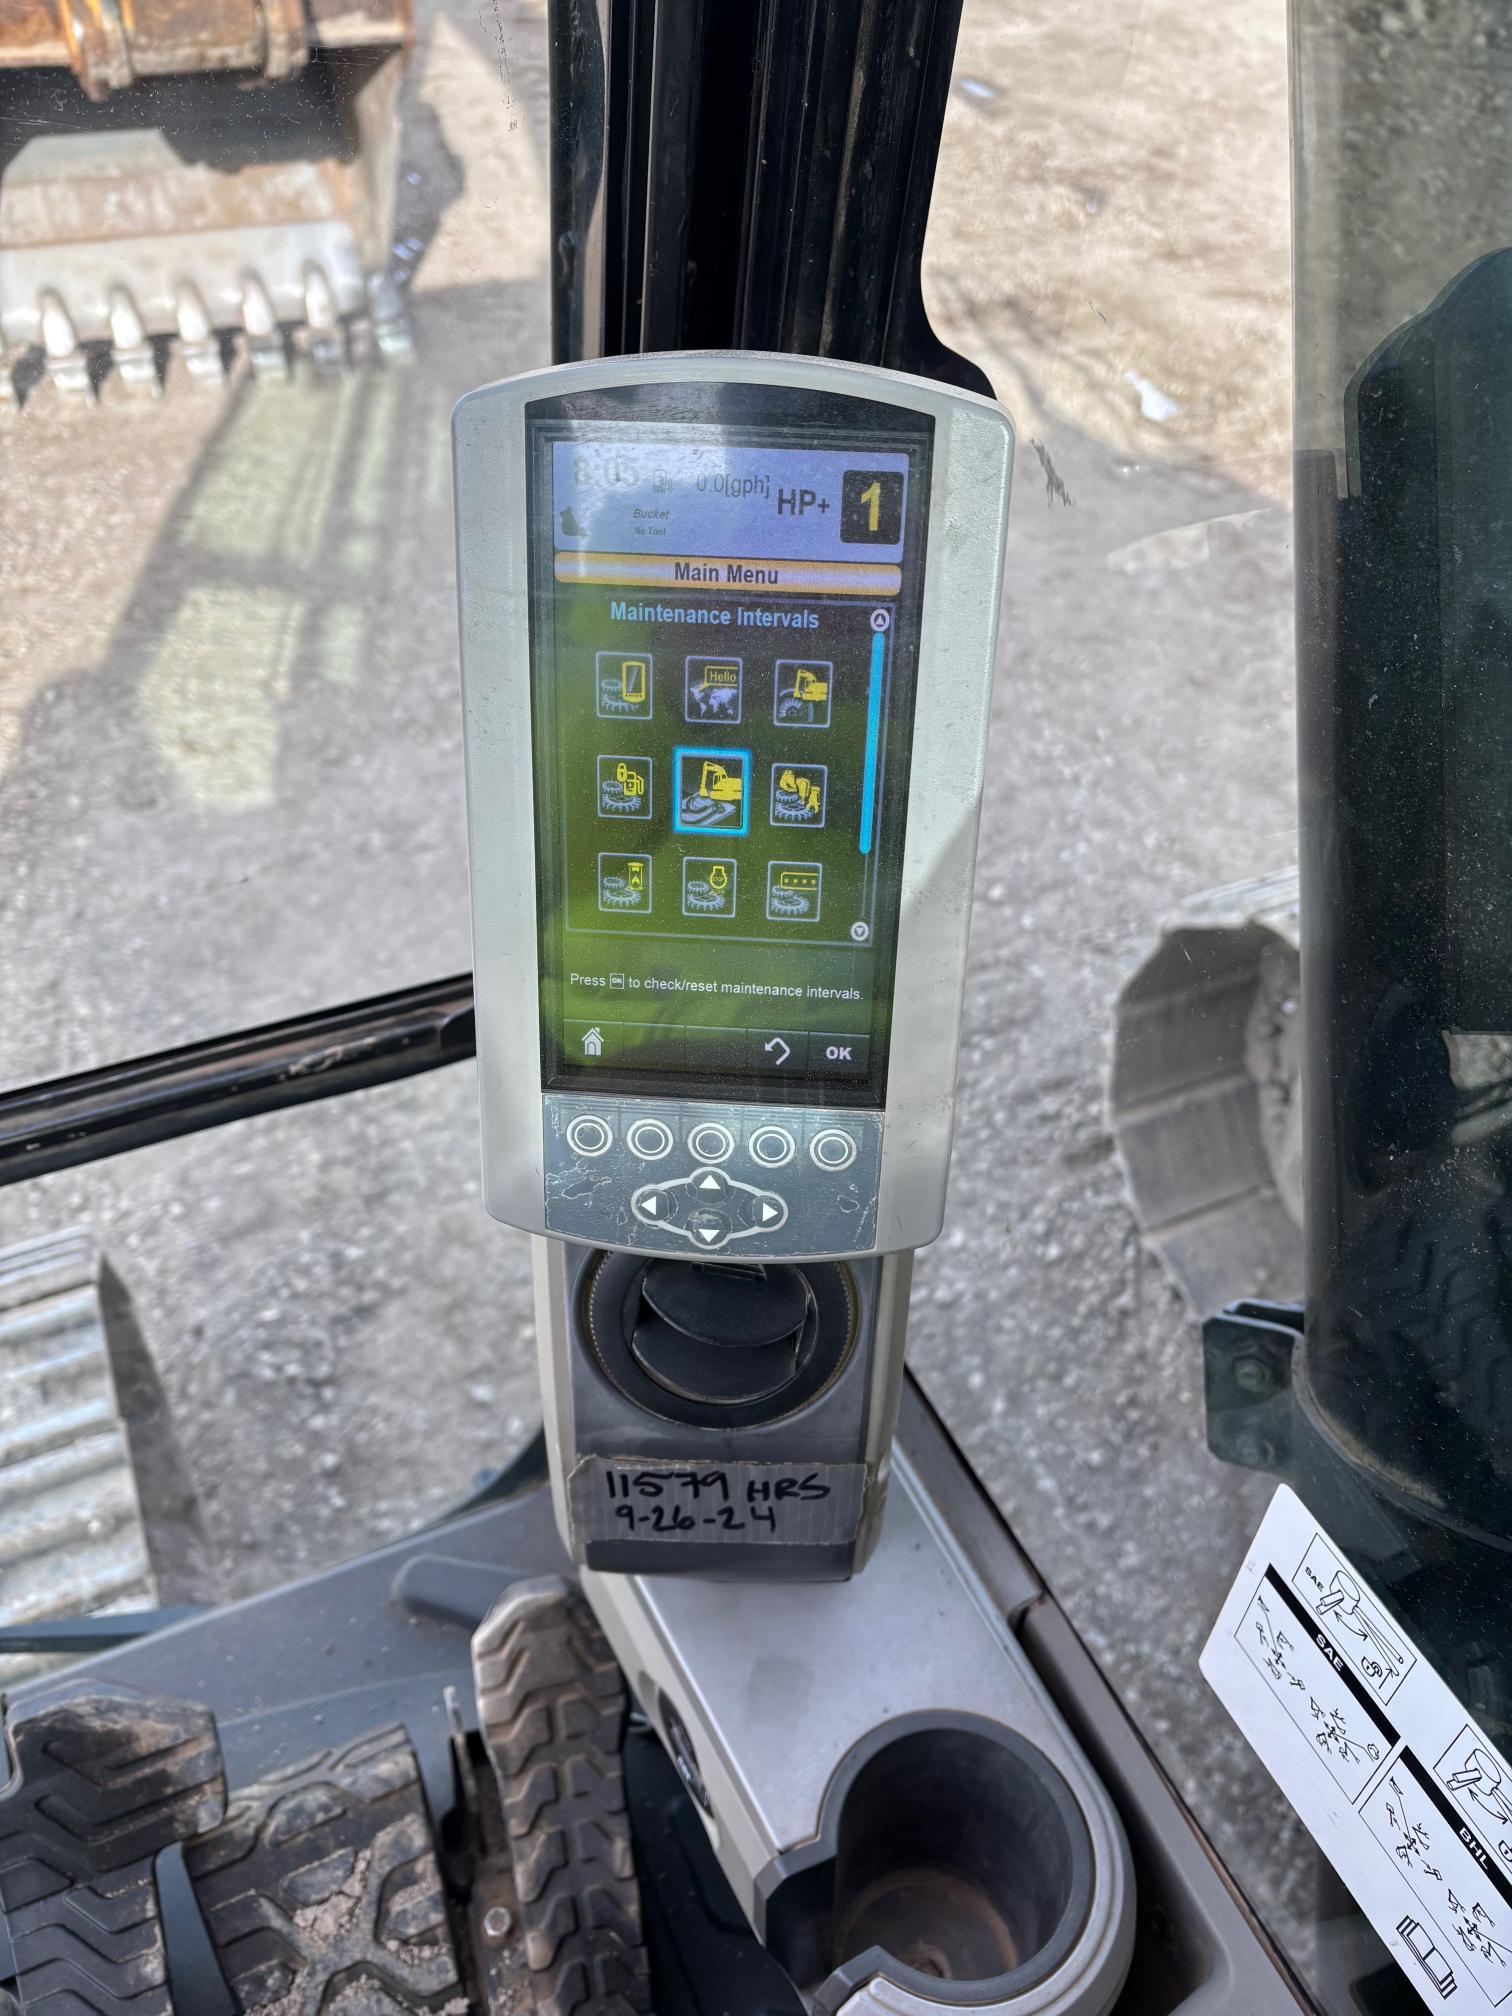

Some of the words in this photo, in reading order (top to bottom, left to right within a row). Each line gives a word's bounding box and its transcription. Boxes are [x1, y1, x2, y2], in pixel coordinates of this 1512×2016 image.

[633, 508, 670, 520] Bucket
[777, 488, 830, 515] HP+
[860, 481, 881, 532] 1
[634, 527, 646, 535] No
[648, 527, 666, 536] Tool
[674, 562, 720, 583] Main
[727, 564, 779, 585] Menu
[610, 601, 731, 626] Maintenance
[737, 607, 820, 629] Intervals
[710, 670, 737, 682] Hello
[570, 973, 606, 987] Press
[628, 977, 640, 989] to
[644, 977, 718, 993] check/reset
[721, 981, 803, 998] maintenance
[806, 986, 864, 1000] intervals.
[826, 1046, 852, 1061] OK
[606, 1470, 730, 1501] 11579
[746, 1472, 831, 1502] HRS
[615, 1504, 777, 1533] 9-26-24
[1304, 1566, 1324, 1592] SAE
[1315, 1633, 1344, 1671] SAE
[1459, 1827, 1488, 1870] BHL
